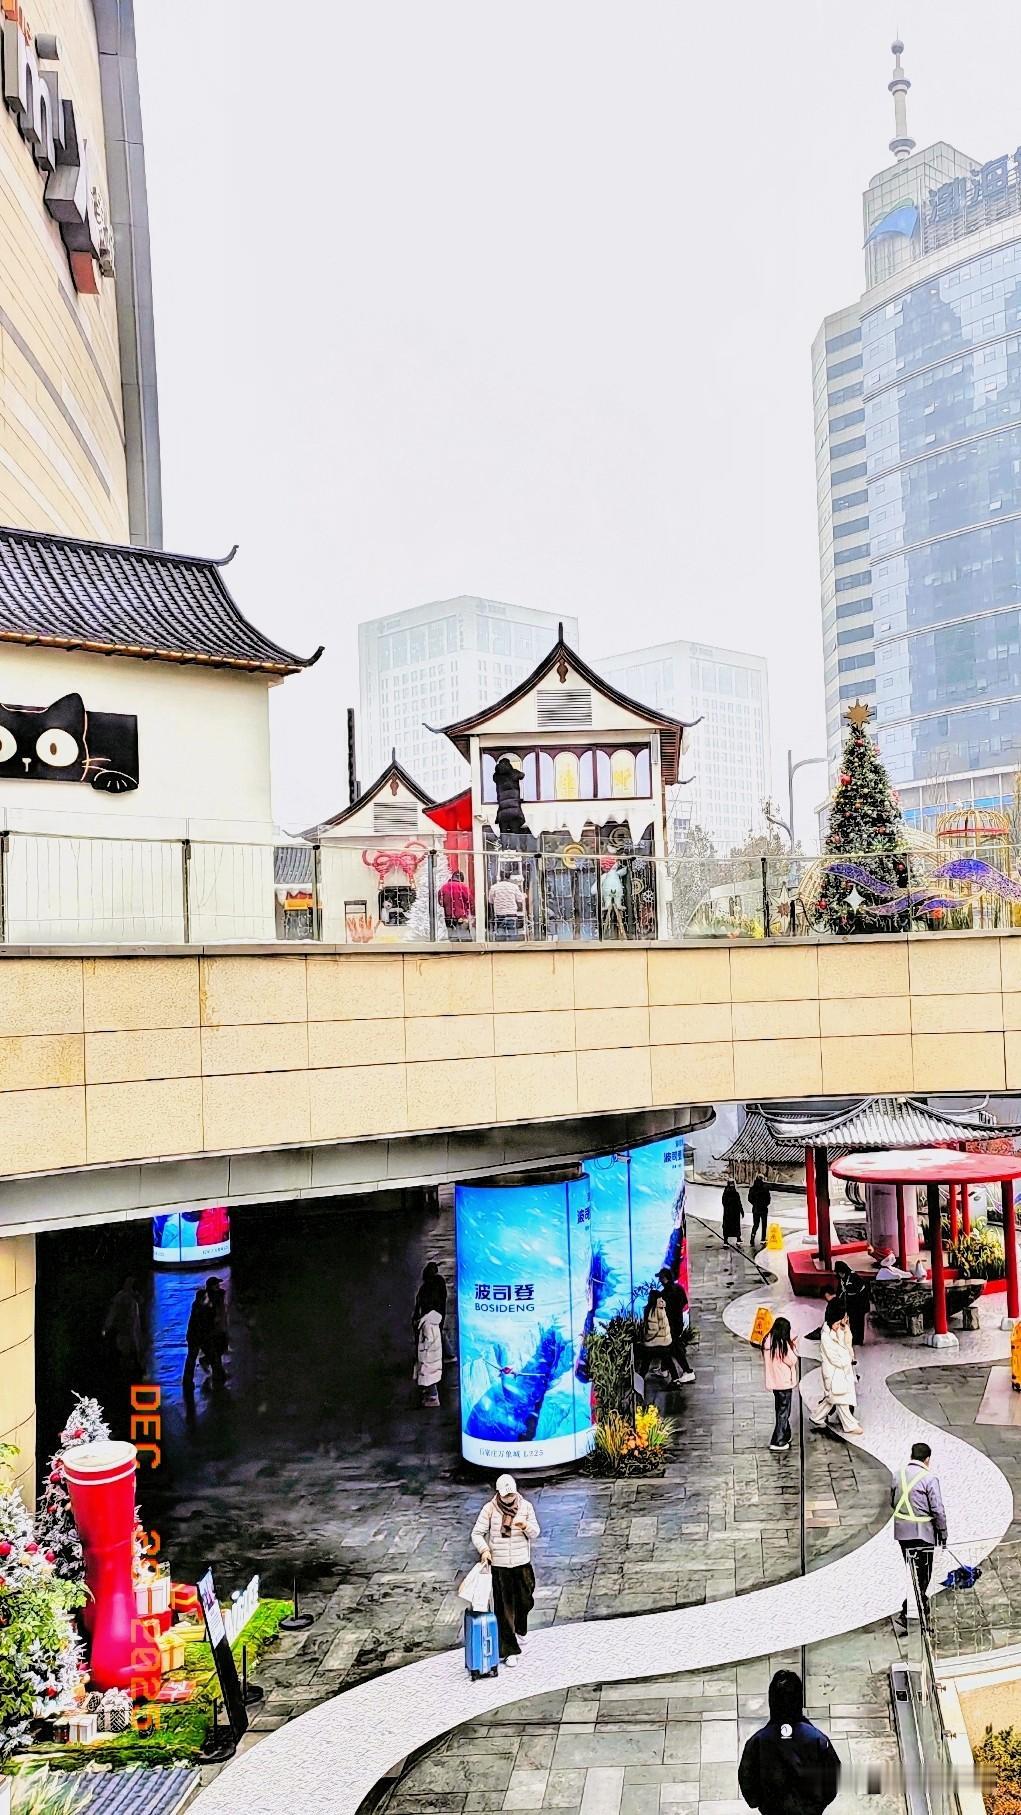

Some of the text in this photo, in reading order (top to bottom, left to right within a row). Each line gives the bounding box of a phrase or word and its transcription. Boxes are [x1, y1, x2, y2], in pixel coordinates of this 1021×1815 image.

[474, 1283, 535, 1301] 波司登
[474, 1302, 535, 1313] BOSIDENG
